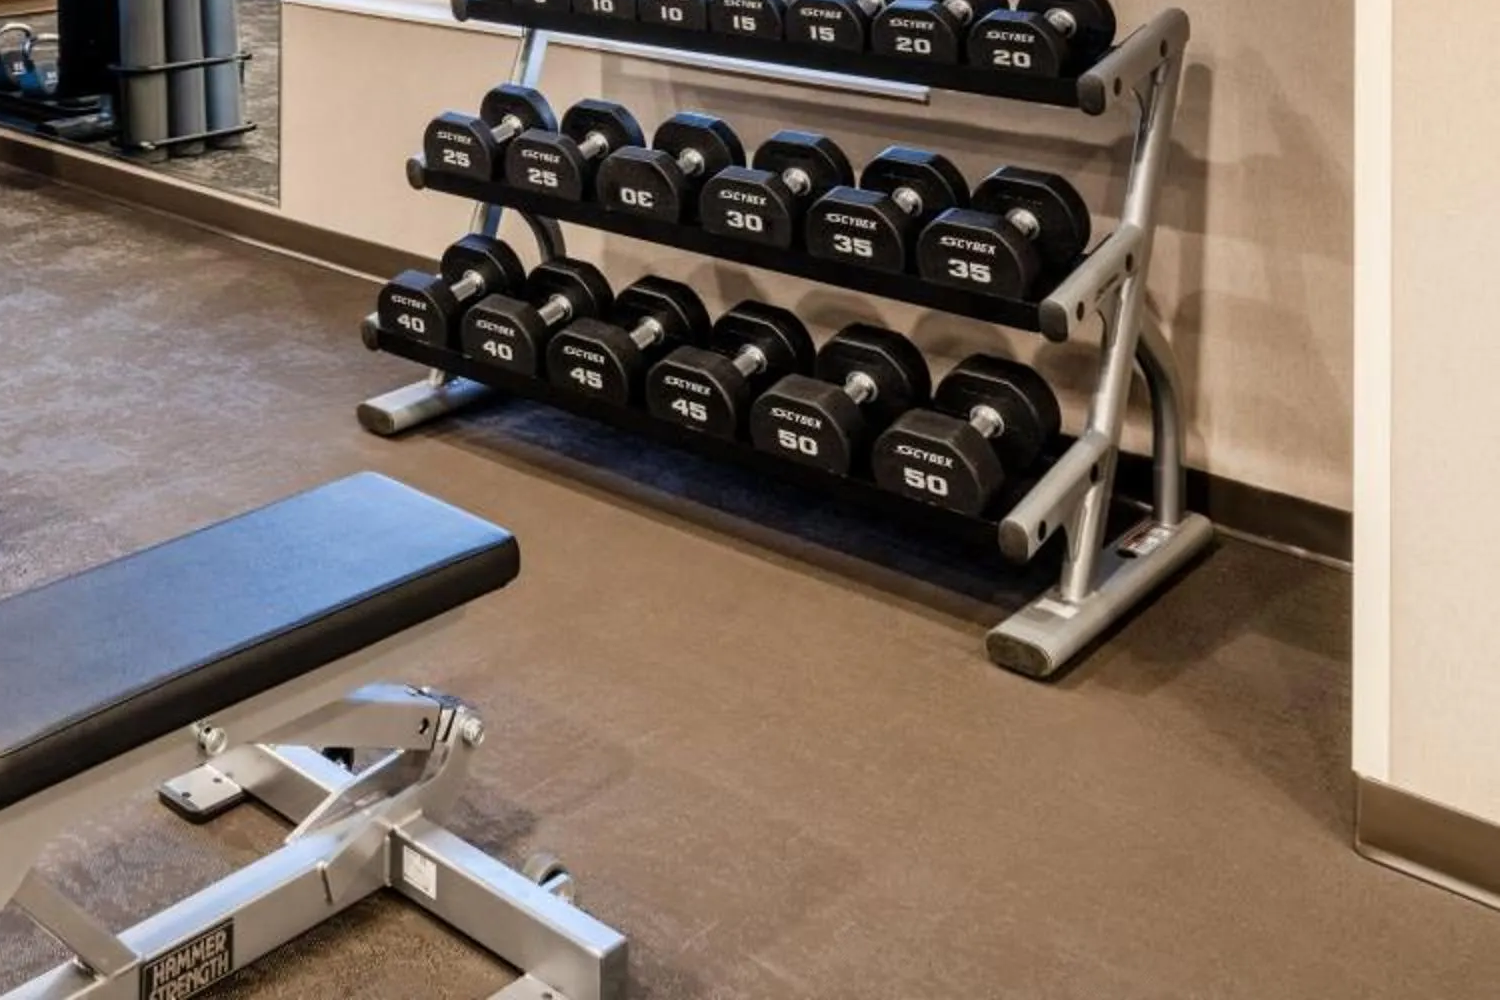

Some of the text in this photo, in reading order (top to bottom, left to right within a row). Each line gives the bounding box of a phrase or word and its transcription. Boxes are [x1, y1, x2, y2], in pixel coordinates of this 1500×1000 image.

[660, 5, 683, 22] 10
[732, 14, 757, 31] 15
[809, 25, 835, 42] 15
[901, 19, 935, 31] CYBEX
[895, 36, 932, 54] 20
[1000, 31, 1036, 44] CYBEX
[993, 49, 1031, 68] 20
[446, 131, 472, 145] CYBEX
[442, 149, 471, 168] 25
[531, 150, 561, 164] CYBEX
[526, 167, 559, 188] 25
[732, 191, 767, 206] CYBEX
[725, 210, 764, 232] 30
[840, 215, 877, 231] CYBEX
[832, 233, 874, 258] 35
[956, 236, 997, 255] CYBEX
[947, 258, 992, 283] 35
[401, 296, 427, 311] CYBEX
[396, 313, 426, 333] 40
[487, 321, 516, 338] CYBEX
[482, 340, 513, 361] 40
[574, 346, 605, 365] CYBEX
[570, 367, 604, 389] 45
[677, 378, 712, 396] CYBEX
[671, 398, 708, 423] 45
[785, 409, 822, 430] CYBEX
[777, 427, 819, 457] 50
[913, 449, 954, 469] CYBEX
[903, 466, 949, 497] 50
[153, 929, 227, 991] HAMMER
